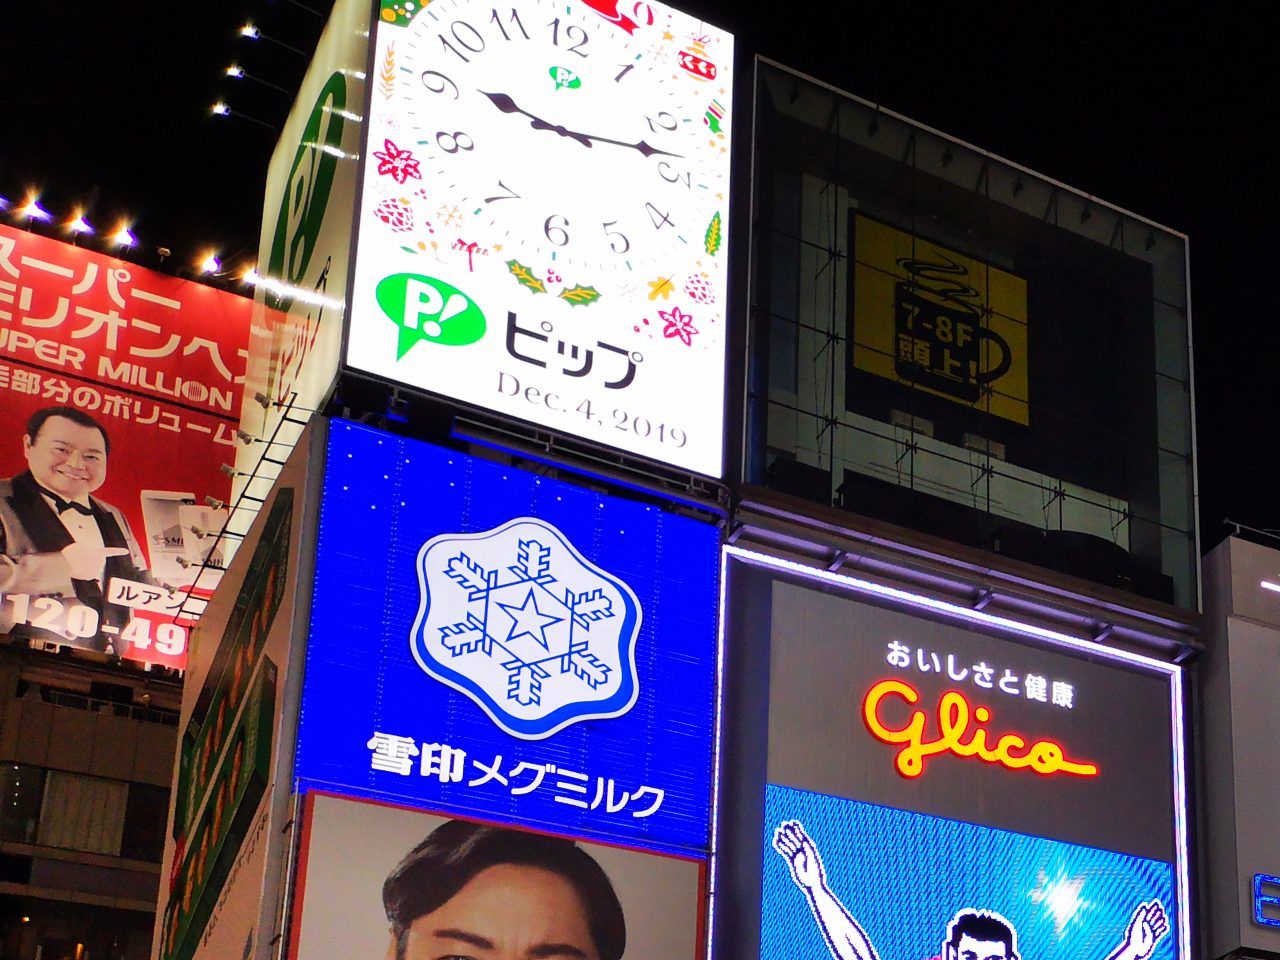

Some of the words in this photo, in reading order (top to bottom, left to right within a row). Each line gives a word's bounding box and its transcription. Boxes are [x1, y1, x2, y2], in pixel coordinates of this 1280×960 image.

[490, 8, 530, 40] 11
[547, 18, 588, 57] 12
[438, 21, 485, 62] 10
[421, 70, 459, 99] 9
[614, 63, 634, 82] 1
[643, 111, 678, 133] 2
[436, 132, 474, 153] 8
[484, 180, 521, 203] 7
[657, 161, 691, 189] 3
[544, 214, 569, 246] 6
[645, 202, 675, 229] 4
[603, 221, 629, 254] 5
[0, 283, 248, 384] リオンヘ
[505, 312, 644, 391] ピップ
[97, 355, 234, 411] MILLION
[497, 371, 567, 419] Dec.
[612, 412, 688, 450] 2019
[886, 640, 1075, 709] おいしさと健康
[862, 679, 1099, 779] Glico
[367, 732, 665, 819] 雪印メグミルク
